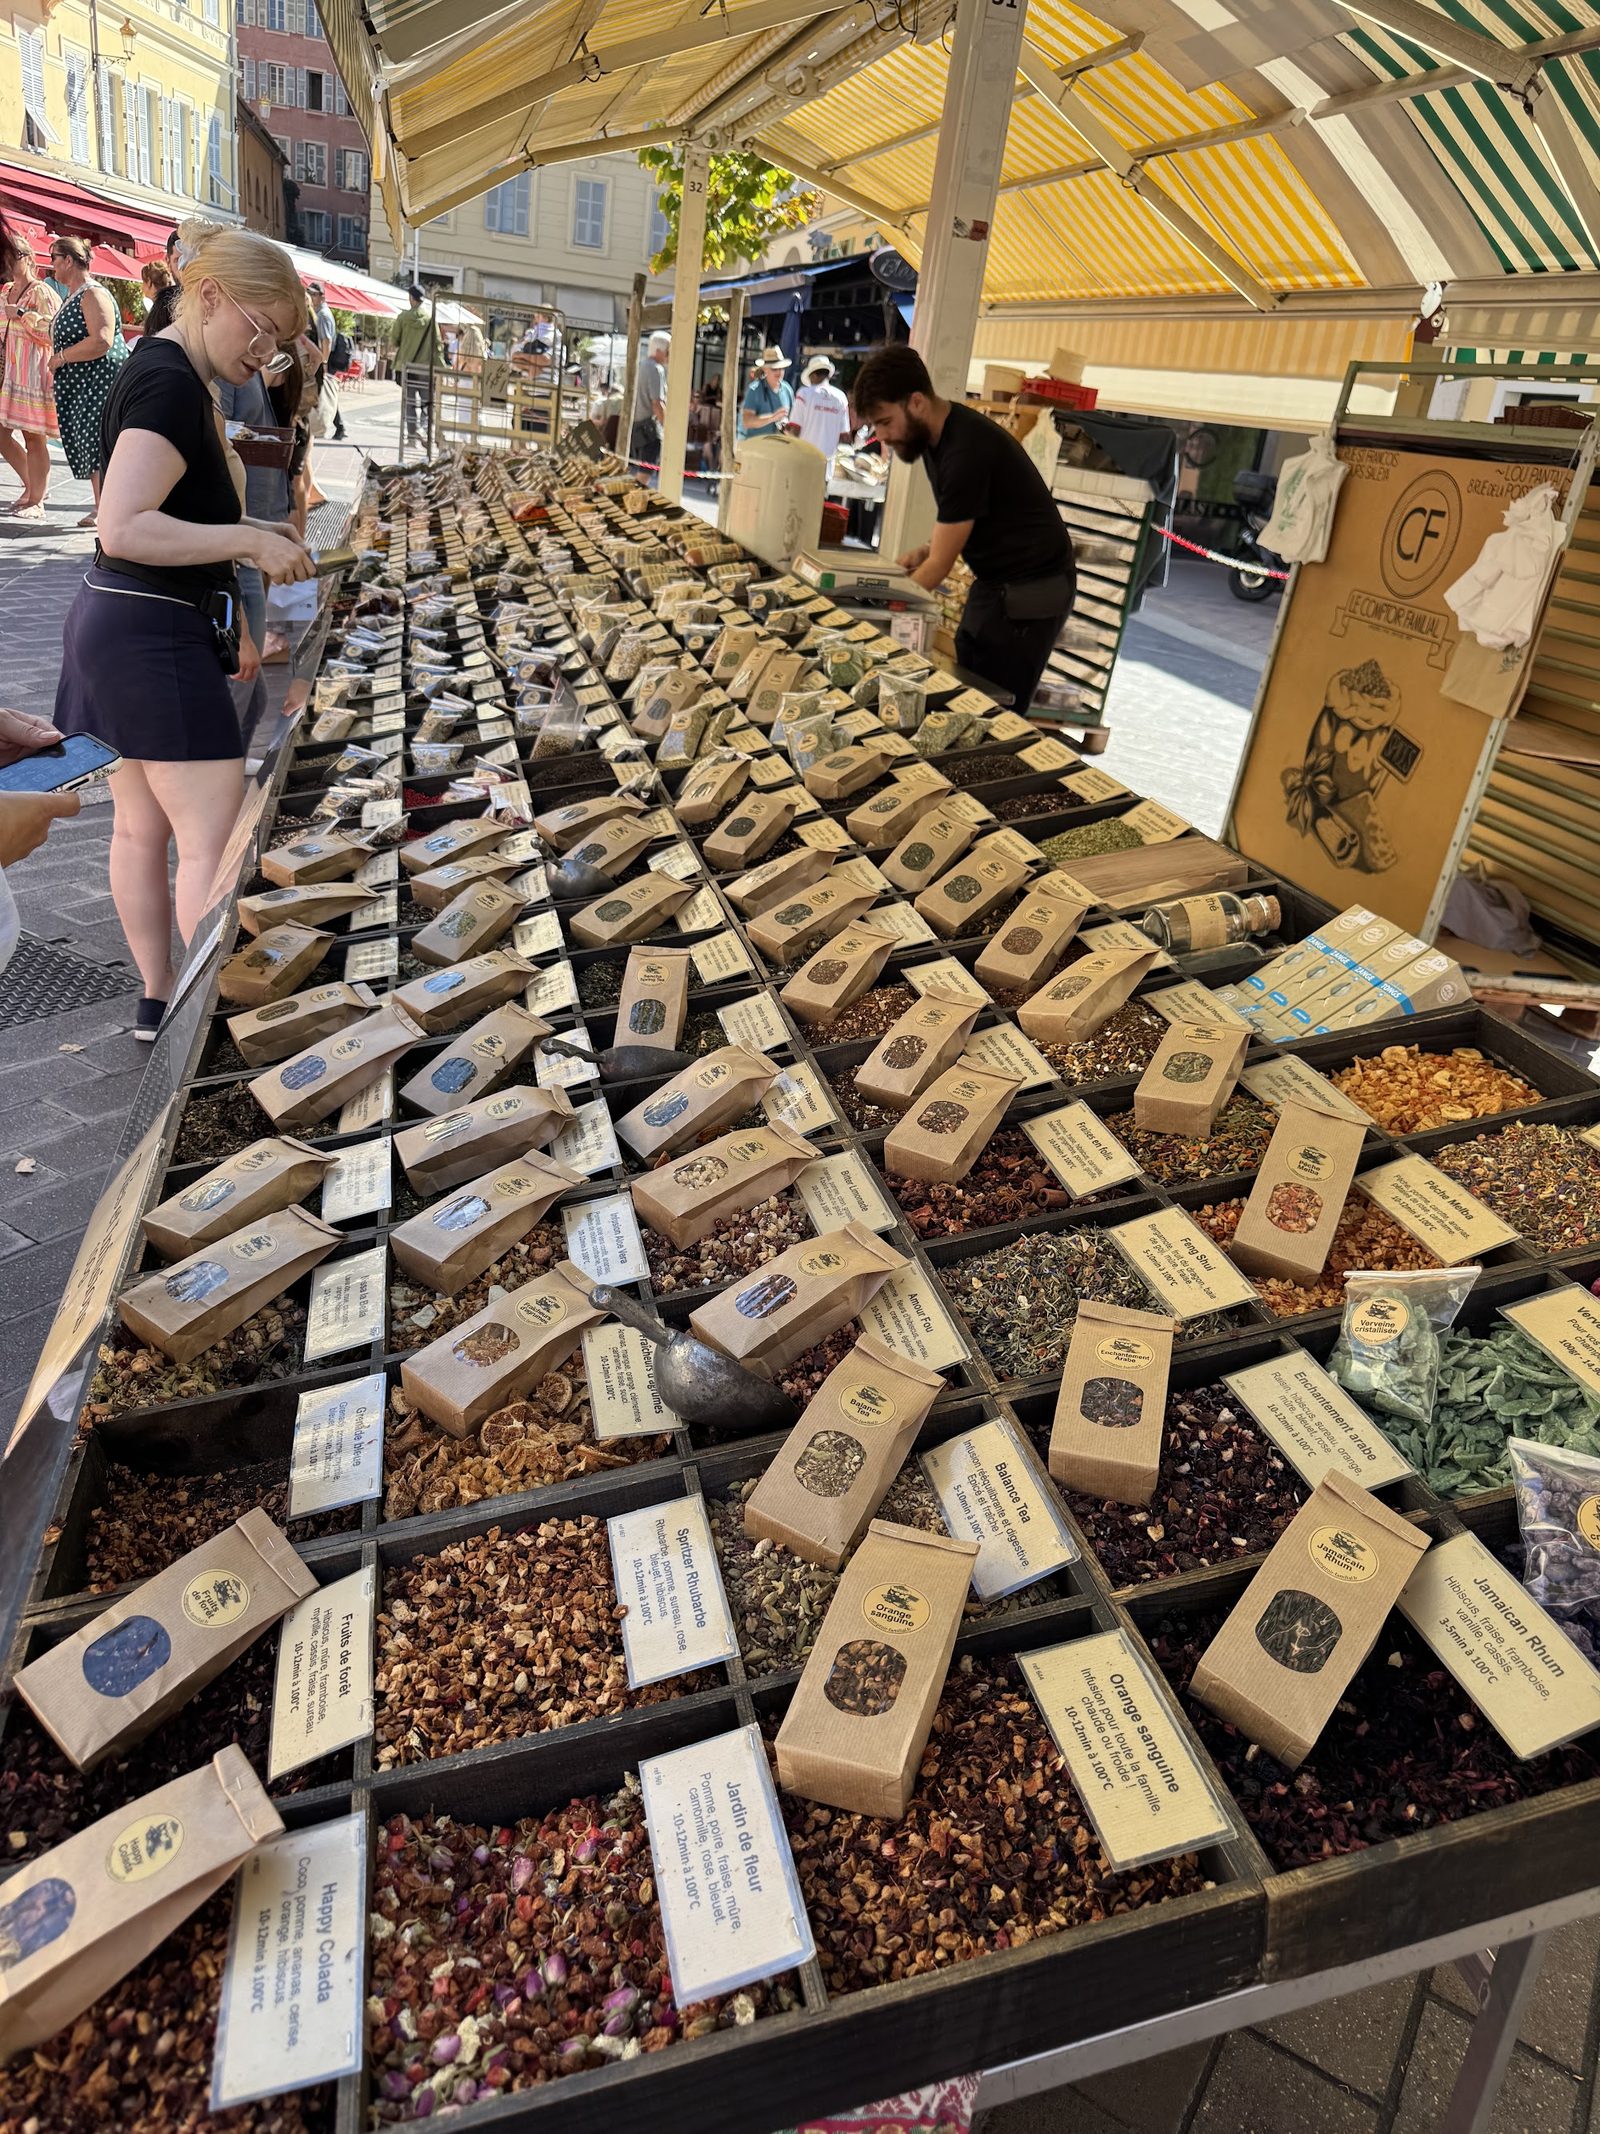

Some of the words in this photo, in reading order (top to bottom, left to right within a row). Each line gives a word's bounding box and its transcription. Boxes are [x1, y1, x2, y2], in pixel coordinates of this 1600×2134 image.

[690, 181, 702, 193] 32
[1396, 507, 1447, 563] CF
[1205, 897, 1218, 913] thé
[1307, 936, 1326, 951] ZANGE
[1331, 950, 1350, 965] ZANGE
[1355, 966, 1375, 982] ZANGE
[1379, 983, 1402, 999] TONGS
[1076, 1121, 1094, 1140] Fraises
[1092, 1140, 1102, 1148] en
[1099, 1147, 1113, 1161] folie
[1297, 1166, 1319, 1176] Melba
[1299, 1160, 1320, 1171] Pêche
[841, 1169, 855, 1186] Bitter
[849, 1184, 868, 1212] Limonade
[1424, 1180, 1449, 1200] Pêche
[1449, 1199, 1474, 1220] Melba
[610, 1212, 620, 1237] Infusion
[618, 1251, 628, 1265] Vera
[1180, 1237, 1196, 1255] Feng
[1196, 1254, 1216, 1272] Shui
[1143, 1249, 1161, 1271] 5-10min
[1163, 1271, 1178, 1287] 100°C
[908, 1293, 925, 1318] Amour
[921, 1317, 934, 1333] Fou
[1354, 1326, 1398, 1334] cristallisée
[1360, 1320, 1395, 1328] Verveine
[1101, 1350, 1150, 1361] Enchantement
[850, 1398, 882, 1415] Balance
[856, 1407, 870, 1418] Tea
[1271, 1371, 1292, 1393] Raisin,
[1289, 1392, 1316, 1422] hibiscus,
[1315, 1420, 1339, 1448] sureau,
[1337, 1446, 1363, 1476] orange,
[1278, 1394, 1296, 1415] mûre,
[1295, 1411, 1316, 1438] bleuet,
[1315, 1437, 1332, 1455] rose.
[1294, 1371, 1354, 1434] Enchantement
[1349, 1432, 1377, 1462] arabe
[1267, 1403, 1294, 1433] 10-12min
[1295, 1435, 1317, 1458] 100°C
[353, 1440, 364, 1467] bleue
[963, 1439, 982, 1468] Infusion
[978, 1466, 1006, 1519] rééquilibrante
[1002, 1518, 1010, 1529] et
[1006, 1527, 1030, 1570] digestive.
[995, 1462, 1021, 1504] Balance
[1016, 1503, 1031, 1524] Tea
[953, 1484, 971, 1516] 5-10min
[970, 1519, 986, 1542] 100°C
[978, 1496, 985, 1506] et
[982, 1505, 998, 1533] fraîche
[655, 1518, 668, 1561] Rhubarbe,
[1317, 1543, 1365, 1571] Jamaicain
[650, 1553, 662, 1582] bleuet,
[661, 1561, 676, 1597] pomme,
[675, 1527, 694, 1571] Spritzer
[686, 1571, 706, 1628] Rhubarbe
[1324, 1552, 1353, 1571] Rhum
[192, 1591, 200, 1600] de
[199, 1600, 215, 1619] forêt
[202, 1590, 219, 1613] Fruits
[633, 1559, 647, 1595] 10-12min
[640, 1603, 653, 1626] 100°C
[655, 1582, 668, 1620] hibiscus.
[875, 1603, 912, 1620] Orange
[310, 1607, 321, 1641] myrtille,
[323, 1608, 333, 1648] Hibiscus,
[340, 1613, 353, 1648] Fruits
[670, 1595, 682, 1629] sureau,
[870, 1609, 915, 1627] sanguine
[1473, 1576, 1528, 1636] Jamaican
[1525, 1635, 1564, 1678] Rhum
[308, 1641, 318, 1672] cassis,
[339, 1649, 352, 1666] de
[676, 1630, 687, 1654] rose,
[1439, 1617, 1468, 1651] 3-5min
[1464, 1649, 1473, 1657] à
[1471, 1656, 1499, 1684] 100°C
[1444, 1575, 1480, 1618] Hibiscus,
[1479, 1617, 1505, 1648] fraise,
[1505, 1647, 1551, 1702] framboise,
[1456, 1608, 1483, 1642] vanille,
[1484, 1641, 1512, 1676] cassis.
[292, 1641, 303, 1681] 10-12min
[320, 1648, 329, 1677] mûre,
[290, 1688, 300, 1713] 100°C
[307, 1672, 318, 1701] fraise,
[317, 1676, 329, 1724] framboise,
[338, 1667, 352, 1698] forêt
[305, 1702, 315, 1738] sureau.
[1065, 1705, 1092, 1752] 10-12min
[1109, 1673, 1142, 1723] Orange
[1137, 1725, 1180, 1793] sanguine
[1081, 1696, 1105, 1734] chaude
[1101, 1736, 1115, 1750] ou
[1109, 1750, 1130, 1783] froide
[1081, 1668, 1105, 1706] Infusion
[1102, 1707, 1120, 1733] pour
[1116, 1731, 1134, 1761] toute
[1131, 1761, 1140, 1773] la
[1136, 1773, 1161, 1816] famille,
[1088, 1753, 1099, 1761] à
[700, 1772, 717, 1816] Pomme,
[1092, 1760, 1114, 1791] 100°C
[727, 1781, 747, 1829] Jardin
[127, 1837, 144, 1865] Happy
[672, 1813, 689, 1865] 10-12min
[709, 1820, 724, 1853] poire,
[737, 1833, 754, 1852] de
[119, 1843, 133, 1874] Colada
[293, 1856, 311, 1895] Coco,
[682, 1864, 692, 1874] à
[688, 1787, 708, 1846] camomille,
[701, 1849, 714, 1881] rose,
[708, 1881, 727, 1926] bleuet.
[716, 1854, 732, 1896] fraise,
[743, 1854, 762, 1893] fleur
[316, 1881, 338, 1935] Happy
[683, 1875, 701, 1910] 100°C
[276, 1900, 291, 1947] orange,
[292, 1895, 307, 1946] pomme,
[726, 1895, 741, 1934] mûre,
[255, 1908, 271, 1963] 10-12min
[256, 1962, 264, 1971] à
[274, 1948, 290, 2008] hibiscus.
[288, 1947, 303, 2002] ananas,
[316, 1941, 335, 2003] Colada
[252, 1974, 265, 2013] 100°C
[285, 2003, 300, 2052] cerise,
